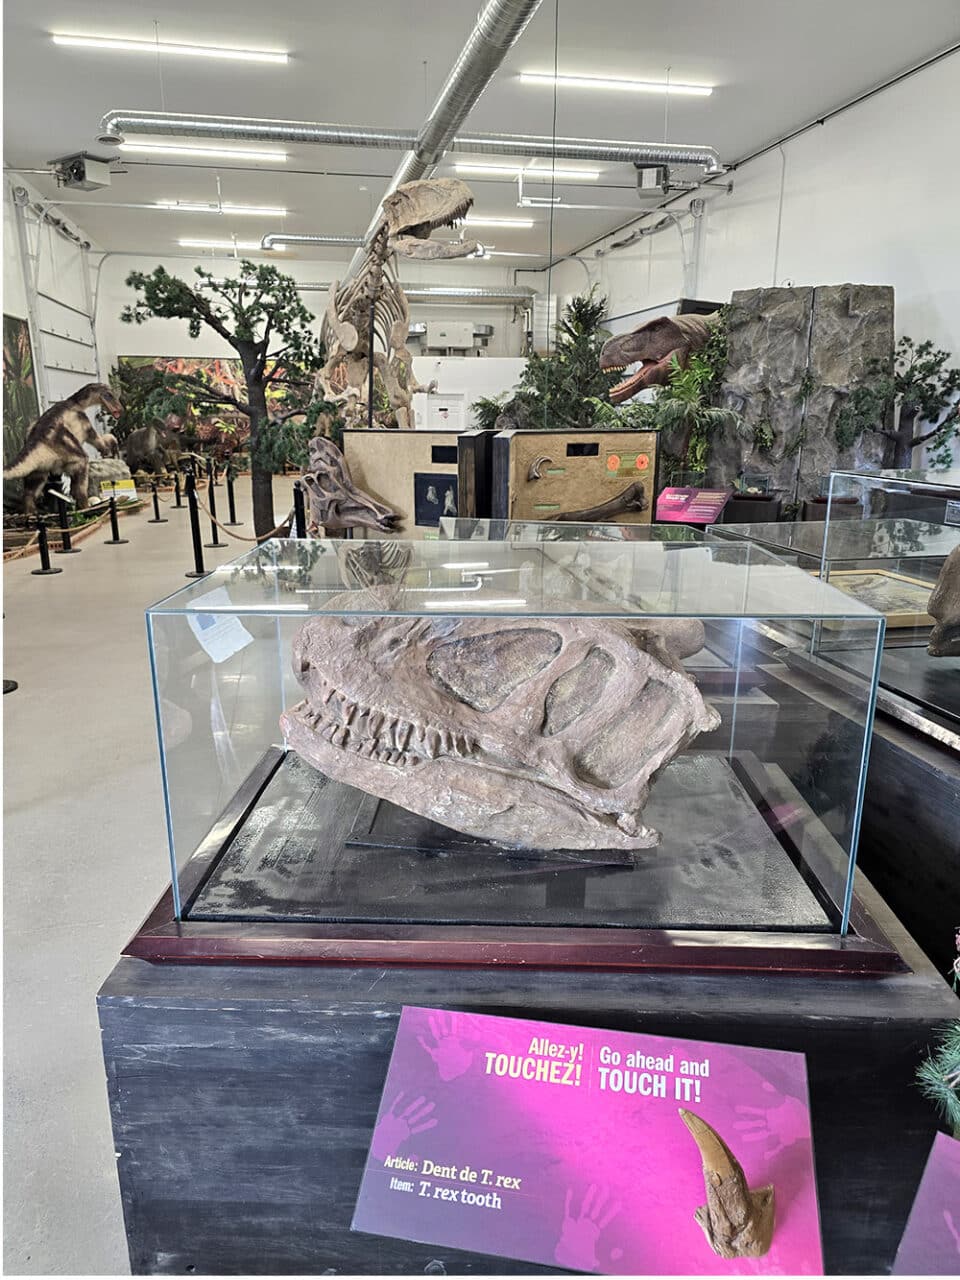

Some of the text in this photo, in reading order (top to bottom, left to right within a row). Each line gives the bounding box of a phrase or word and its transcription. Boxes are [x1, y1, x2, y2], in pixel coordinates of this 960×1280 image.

[528, 1037, 584, 1063] Allez-y!
[599, 1046, 710, 1077] Go ahead and
[485, 1052, 582, 1086] TOUCHEZ!
[598, 1067, 701, 1103] TOUCH IT!
[384, 1155, 522, 1190] Article: Dent de T. rex
[390, 1176, 502, 1209] Item: T. rex tooth
